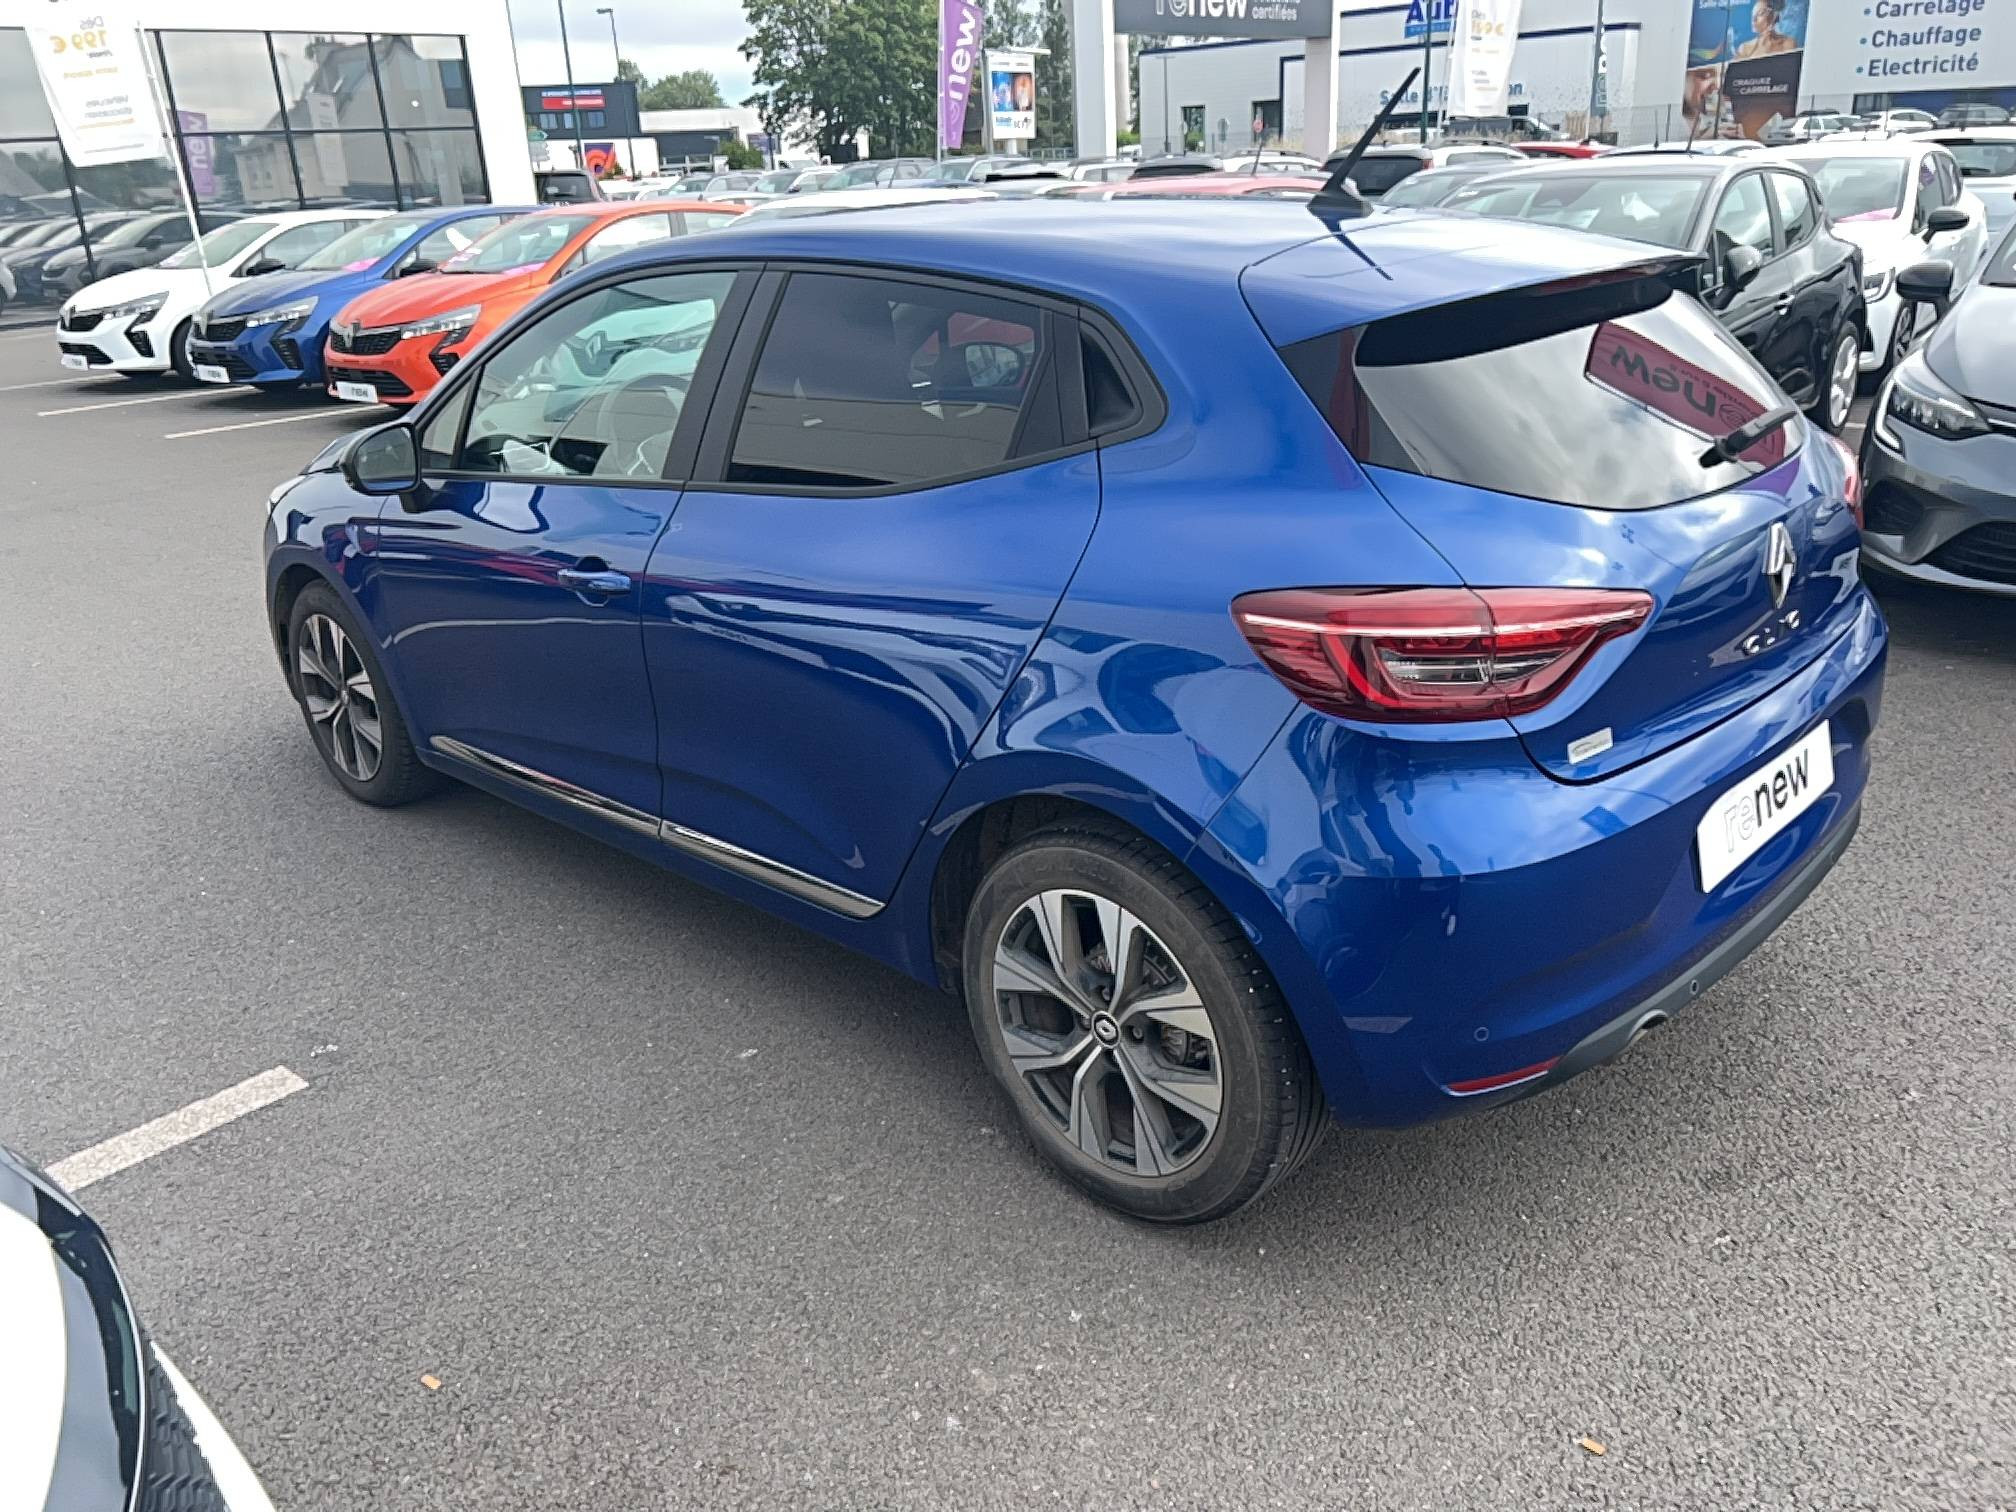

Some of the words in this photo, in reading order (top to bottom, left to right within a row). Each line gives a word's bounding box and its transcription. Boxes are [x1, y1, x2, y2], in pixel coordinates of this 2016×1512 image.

[1875, 0, 1986, 18] Carrelage
[1872, 26, 1982, 47] Chauffage
[1868, 52, 1979, 77] Electricité
[1723, 748, 1809, 854] renew
